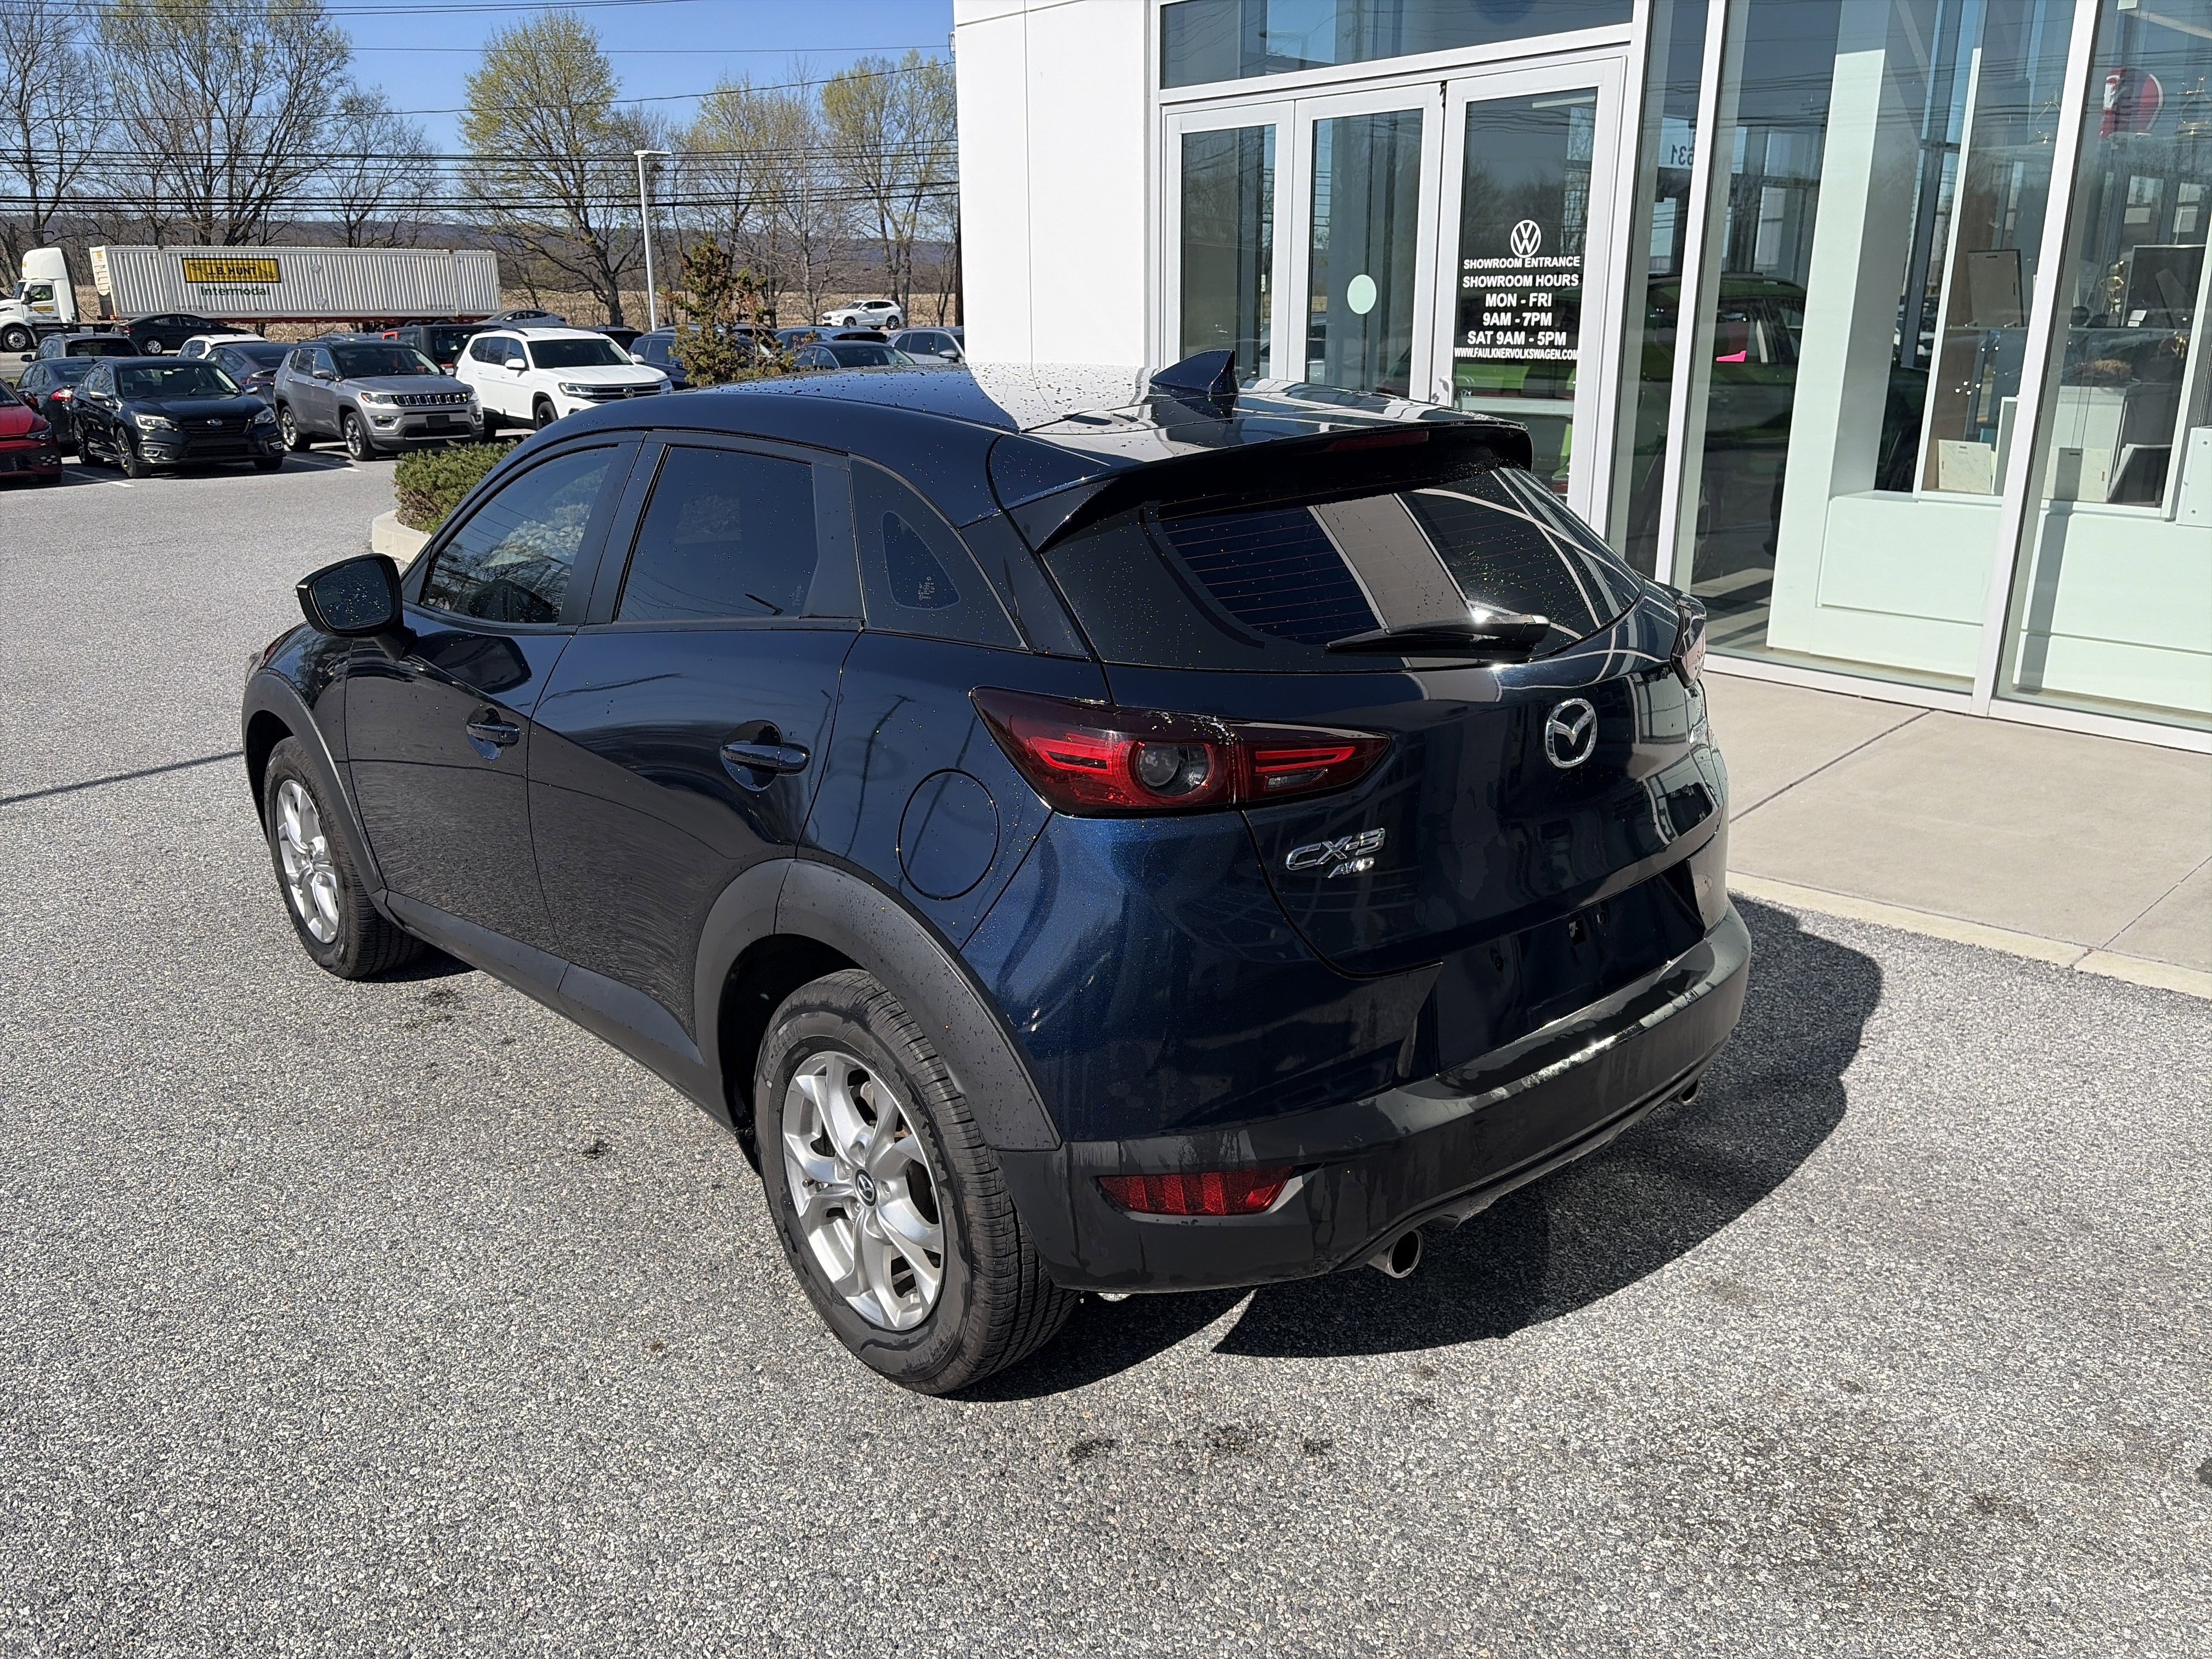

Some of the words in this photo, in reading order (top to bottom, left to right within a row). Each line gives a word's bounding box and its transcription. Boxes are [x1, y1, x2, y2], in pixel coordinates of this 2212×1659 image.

[1463, 258, 1522, 269] SHOWROOM
[1525, 256, 1581, 268] ENTRANCE
[228, 267, 256, 275] HUNT
[1463, 275, 1533, 288] SHOWROOM
[1536, 274, 1579, 287] HOURS
[200, 286, 270, 296] Intermodal
[1485, 293, 1517, 307] MON
[1529, 293, 1552, 307] FRI
[1482, 312, 1511, 326] 9AM
[1522, 312, 1553, 326] 7PM
[1468, 331, 1494, 345] SAT
[1496, 331, 1526, 345] 9AM
[1537, 332, 1567, 346] 5PM
[1285, 827, 1386, 871] CX-3
